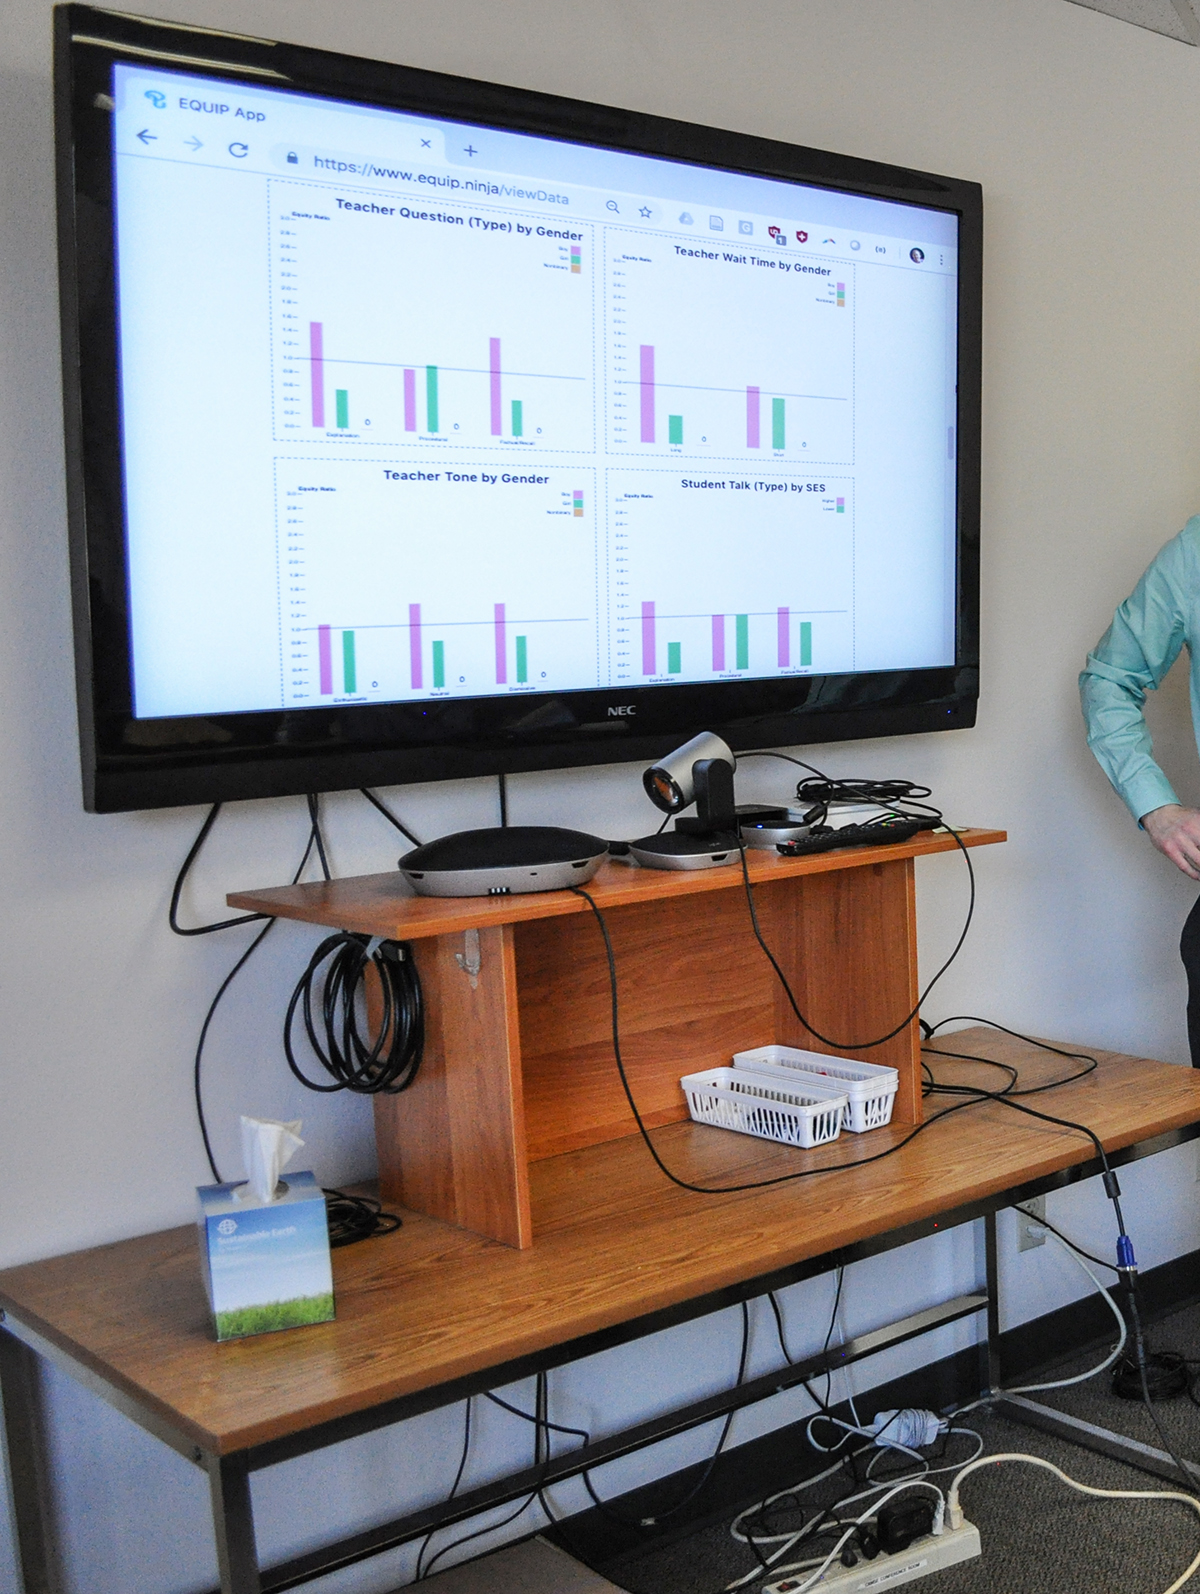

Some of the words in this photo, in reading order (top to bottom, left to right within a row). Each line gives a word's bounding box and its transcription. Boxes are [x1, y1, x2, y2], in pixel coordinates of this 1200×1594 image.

[178, 97, 230, 116] EQUIP
[234, 106, 266, 124] App
[314, 155, 570, 205] https://www.equip.ninja/viewData
[335, 198, 396, 217] Teacher
[399, 207, 465, 226] Question
[468, 216, 512, 234] (Type)
[516, 223, 532, 237] by
[536, 226, 584, 242] Gender
[674, 245, 720, 261] Teacher
[722, 252, 748, 265] Wait
[750, 256, 776, 269] Time
[778, 260, 792, 272] by
[793, 263, 832, 277] Gender
[383, 469, 441, 482] Teacher
[444, 471, 478, 483] Tone
[481, 472, 498, 485] by
[501, 473, 550, 485] Gender
[681, 479, 726, 490] Student
[728, 480, 751, 491] Talk
[754, 481, 788, 493] (Type)
[790, 482, 804, 494] by
[806, 483, 826, 493] SES
[607, 705, 637, 717] NEC
[880, 1568, 907, 1582] CONFERENCE
[908, 1562, 921, 1570] ROOM
